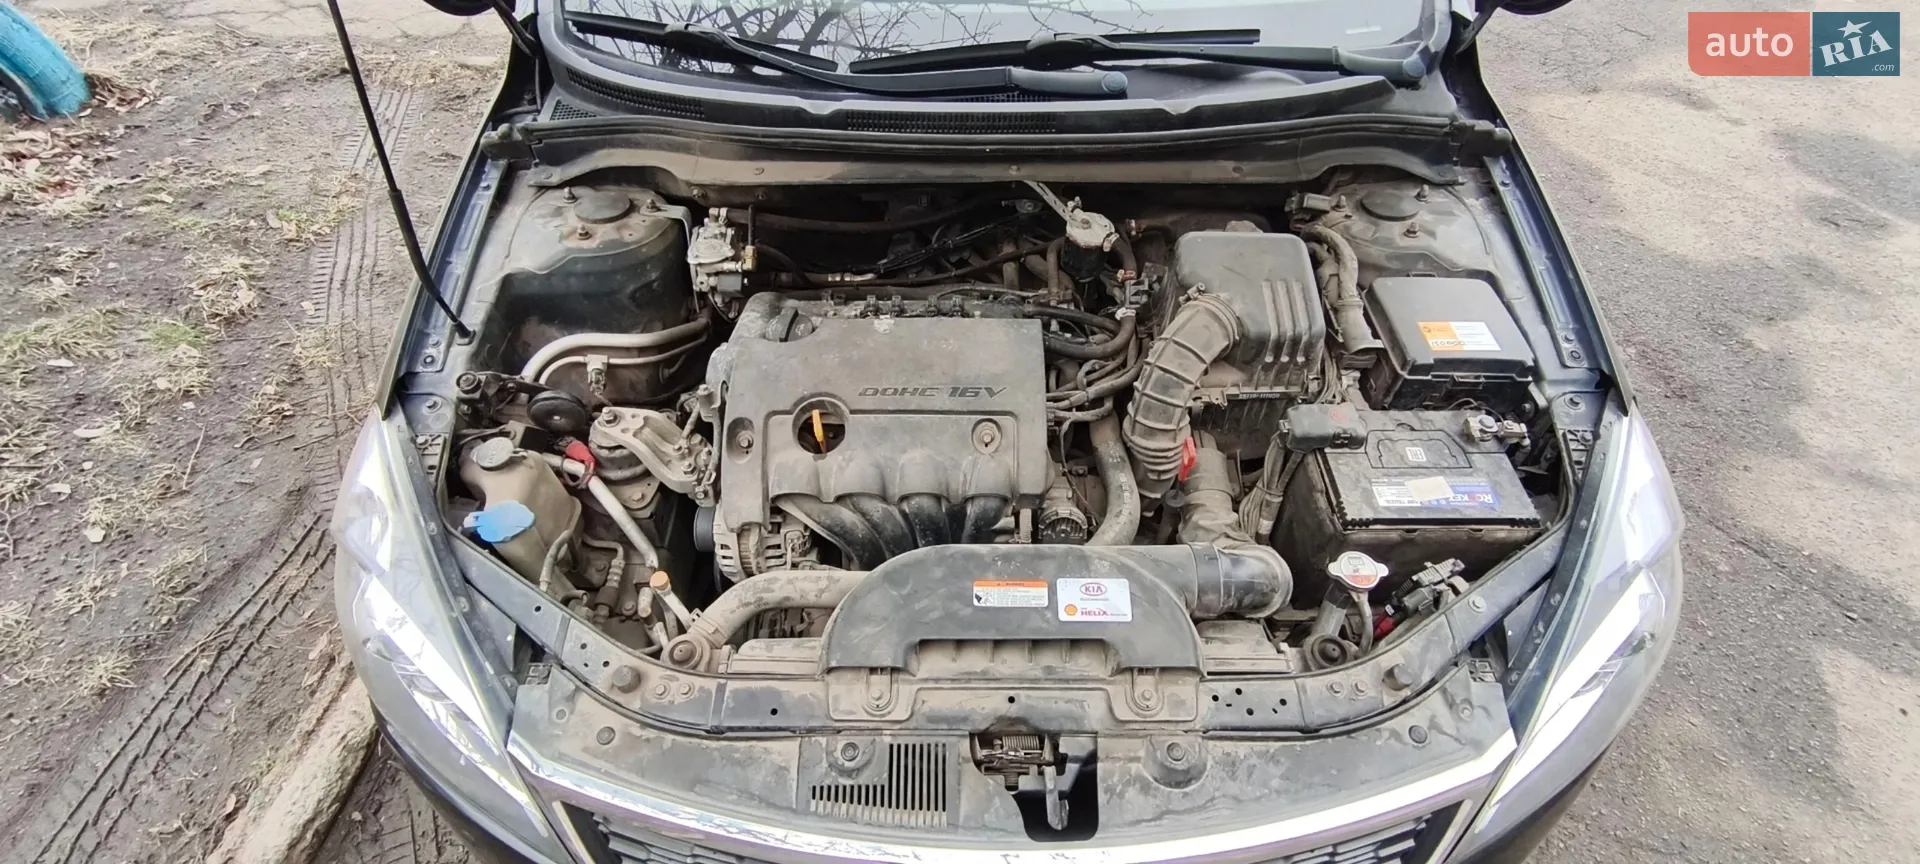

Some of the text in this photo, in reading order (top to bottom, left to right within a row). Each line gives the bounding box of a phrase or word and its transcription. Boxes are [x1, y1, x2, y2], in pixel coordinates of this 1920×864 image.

[858, 386, 1007, 399] DOHC 16V
[1084, 585, 1103, 593] KIA
[1081, 609, 1109, 617] HELIX
